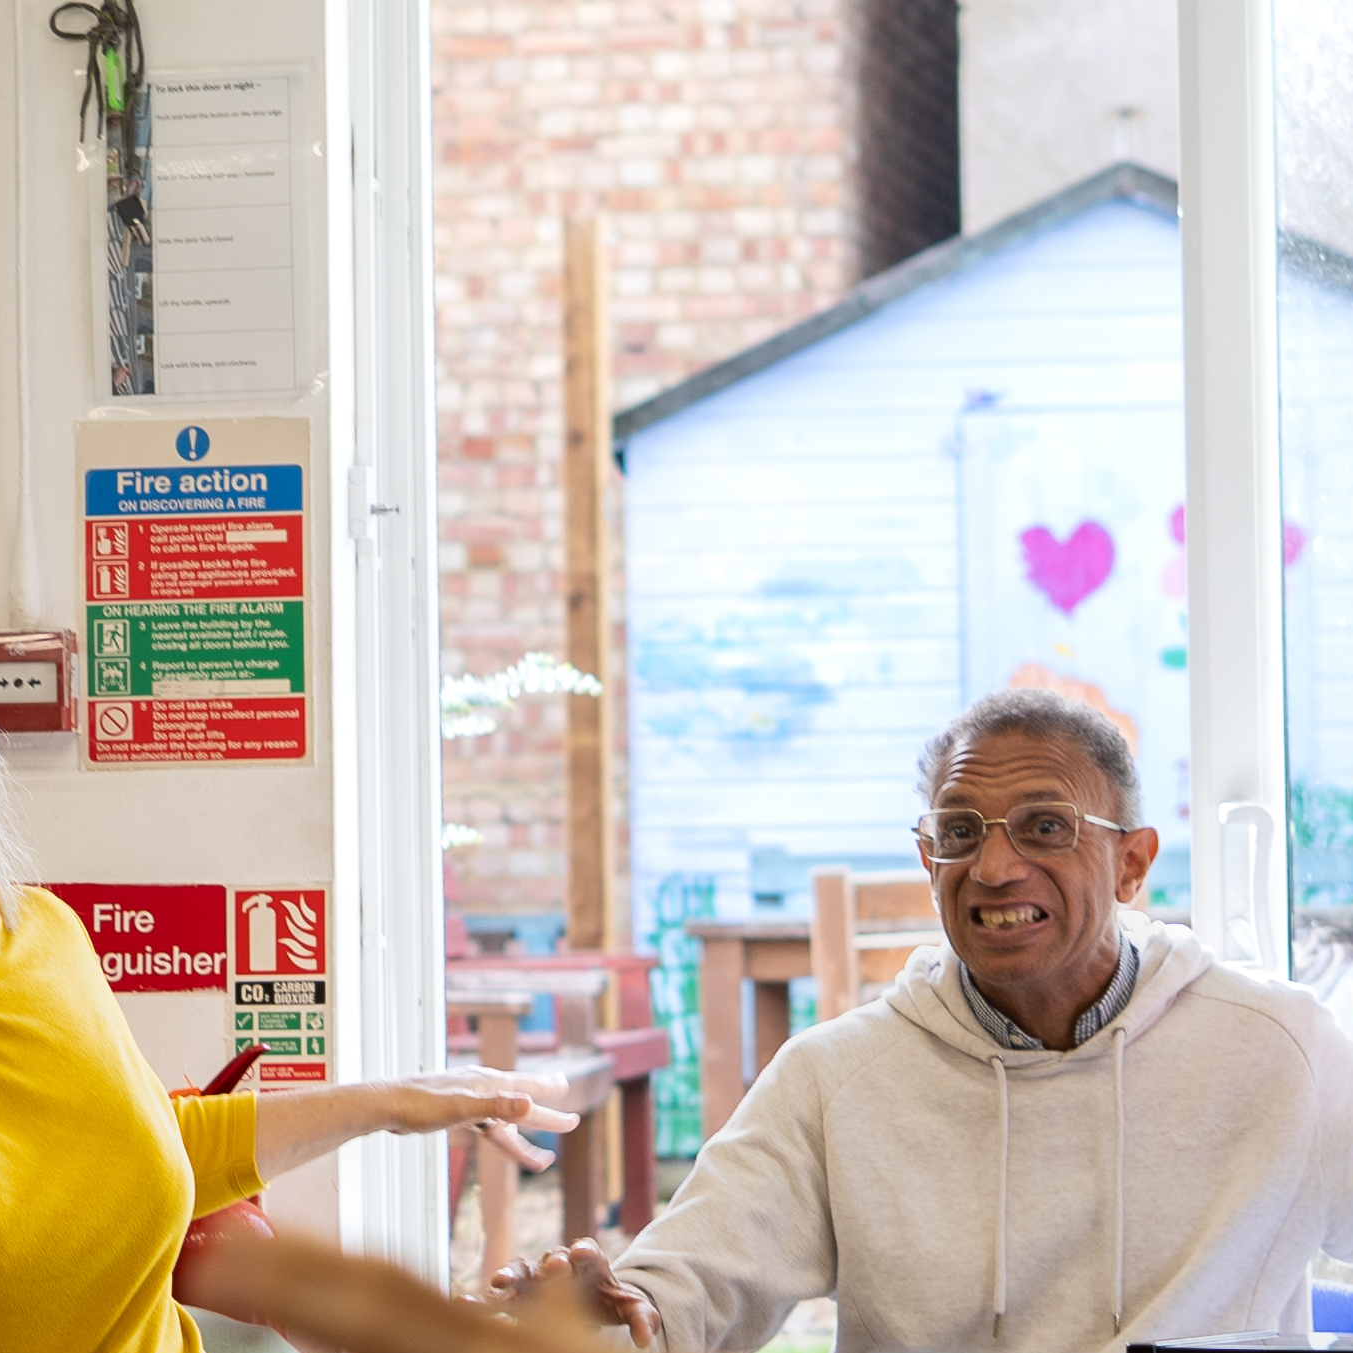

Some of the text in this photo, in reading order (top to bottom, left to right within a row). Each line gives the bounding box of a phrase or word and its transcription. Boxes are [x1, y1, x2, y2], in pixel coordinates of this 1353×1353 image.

[116, 469, 268, 495] Fire action
[118, 497, 266, 512] ON DISCOVERING A FIRE
[181, 544, 197, 553] the
[102, 602, 284, 617] ON HEARING THE FIRE ALARM
[182, 621, 198, 630] the
[255, 619, 271, 628] the
[93, 903, 155, 933] Fire
[97, 945, 227, 982] guisher
[273, 982, 316, 992] CARBON
[274, 993, 316, 1004] DIOXIDE
